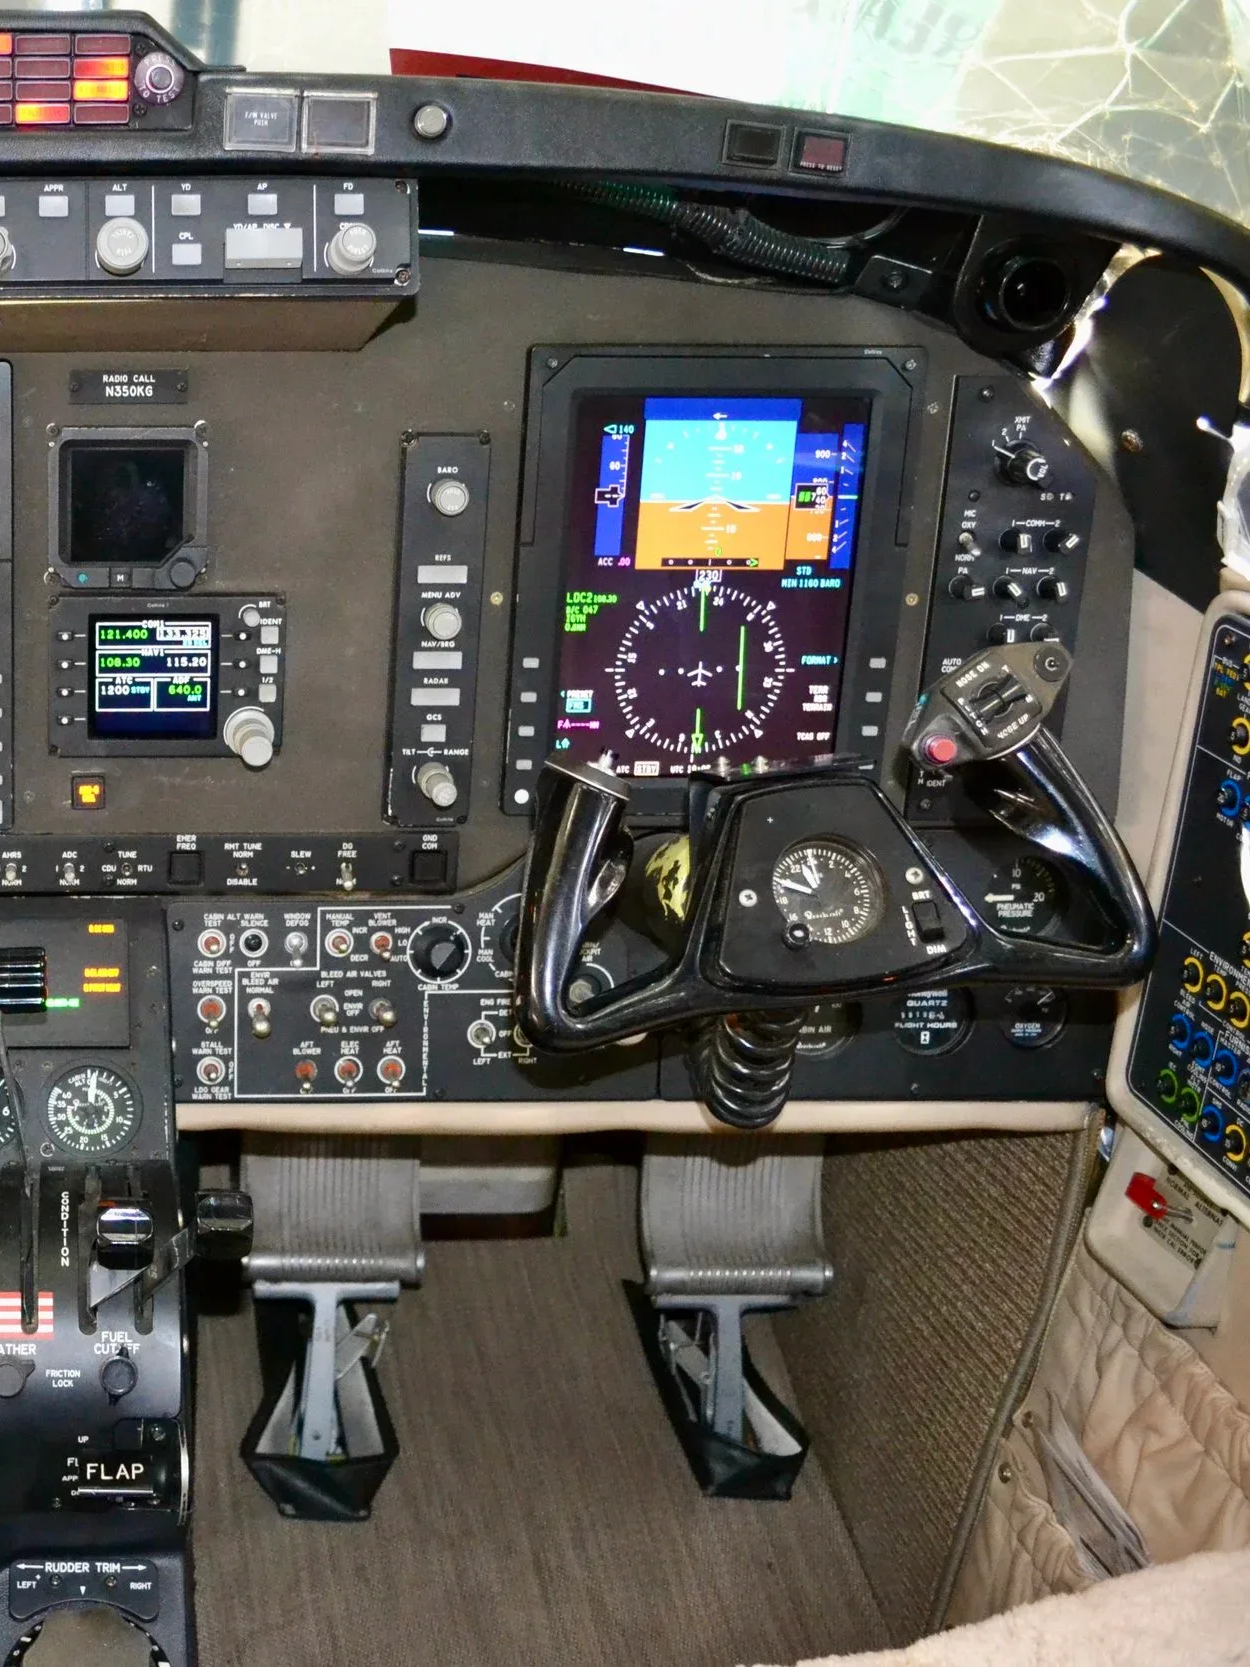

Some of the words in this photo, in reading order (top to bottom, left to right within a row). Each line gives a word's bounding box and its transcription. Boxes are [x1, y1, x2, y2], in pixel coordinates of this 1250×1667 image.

[44, 184, 64, 192] APPR
[112, 184, 127, 192] ALT
[181, 183, 191, 192] YD
[257, 183, 268, 191] AP
[344, 183, 353, 191] FD
[179, 232, 193, 241] CPL
[106, 386, 153, 397] N350KG
[619, 425, 635, 434] 140
[1016, 424, 1027, 432] PA
[962, 521, 976, 529] OXY
[1026, 519, 1046, 527] COMM
[958, 566, 968, 574] PA
[699, 570, 719, 581] 230
[100, 630, 148, 639] 121.400
[100, 657, 140, 667] 108.30
[167, 657, 207, 667] 115.20
[801, 655, 831, 665] FORMAT
[168, 685, 202, 695] 640.0
[224, 842, 239, 851] RMT
[242, 842, 262, 851] TUNE
[422, 842, 438, 850] COM
[117, 851, 137, 859] TUNE
[233, 850, 254, 859] NORM
[290, 850, 311, 859] SLEW
[337, 850, 357, 858] FREE
[116, 878, 137, 886] NORM
[226, 878, 258, 886] DISABLE
[912, 890, 931, 900] BRT
[1033, 892, 1045, 902] 20
[926, 945, 947, 955] DIM
[316, 980, 334, 988] LEFT
[101, 1332, 132, 1343] FUEL
[46, 1369, 80, 1378] FRICTION
[52, 1379, 73, 1388] LOCK
[78, 1435, 89, 1444] UP
[85, 1464, 144, 1480] FLAP
[44, 1561, 91, 1574] RUDDER
[94, 1562, 121, 1574] TRIM
[16, 1580, 37, 1590] LEFT
[130, 1582, 152, 1591] RIGHT
